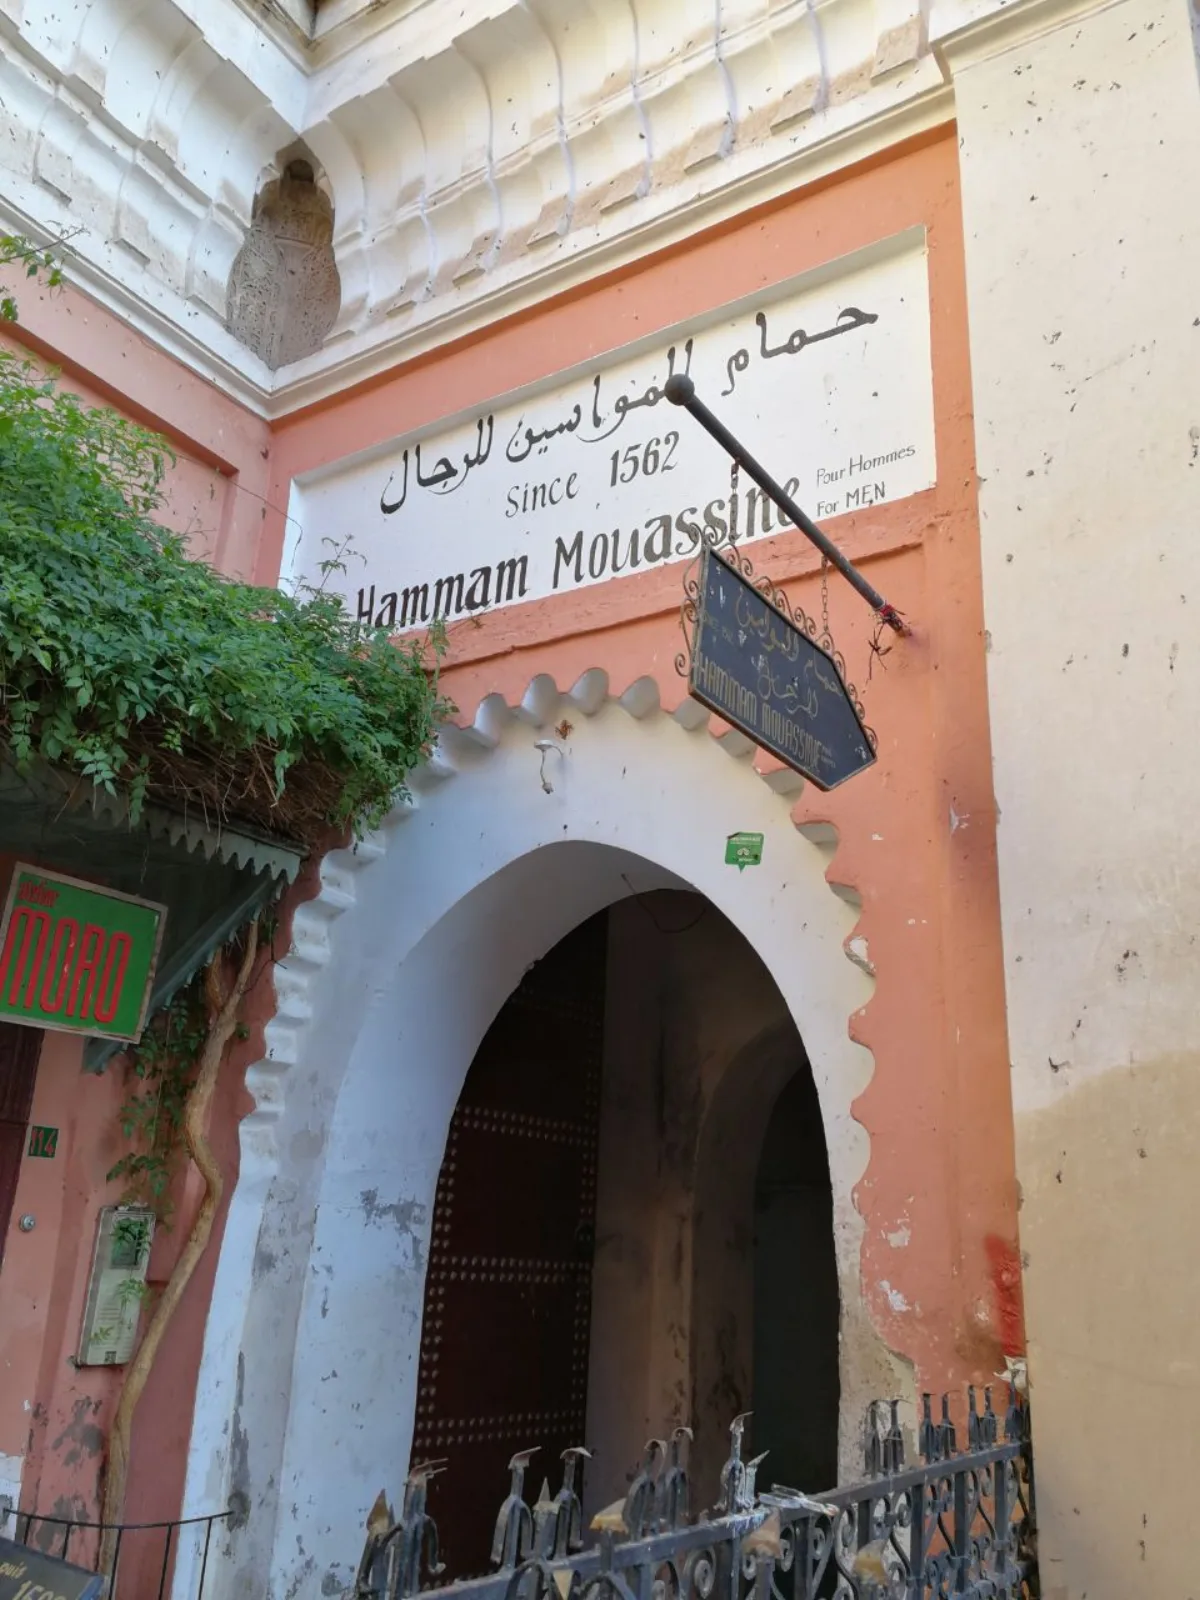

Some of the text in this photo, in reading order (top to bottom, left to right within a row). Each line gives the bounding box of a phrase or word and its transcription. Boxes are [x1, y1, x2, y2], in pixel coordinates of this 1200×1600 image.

[721, 307, 878, 396] حمام
[380, 414, 494, 515] للرجال
[610, 431, 680, 488] 1562
[817, 445, 916, 488] Pour Hommes
[817, 481, 886, 517] For MEN
[357, 477, 801, 628] Hammam Mouassine
[0, 906, 134, 1024] MORO
